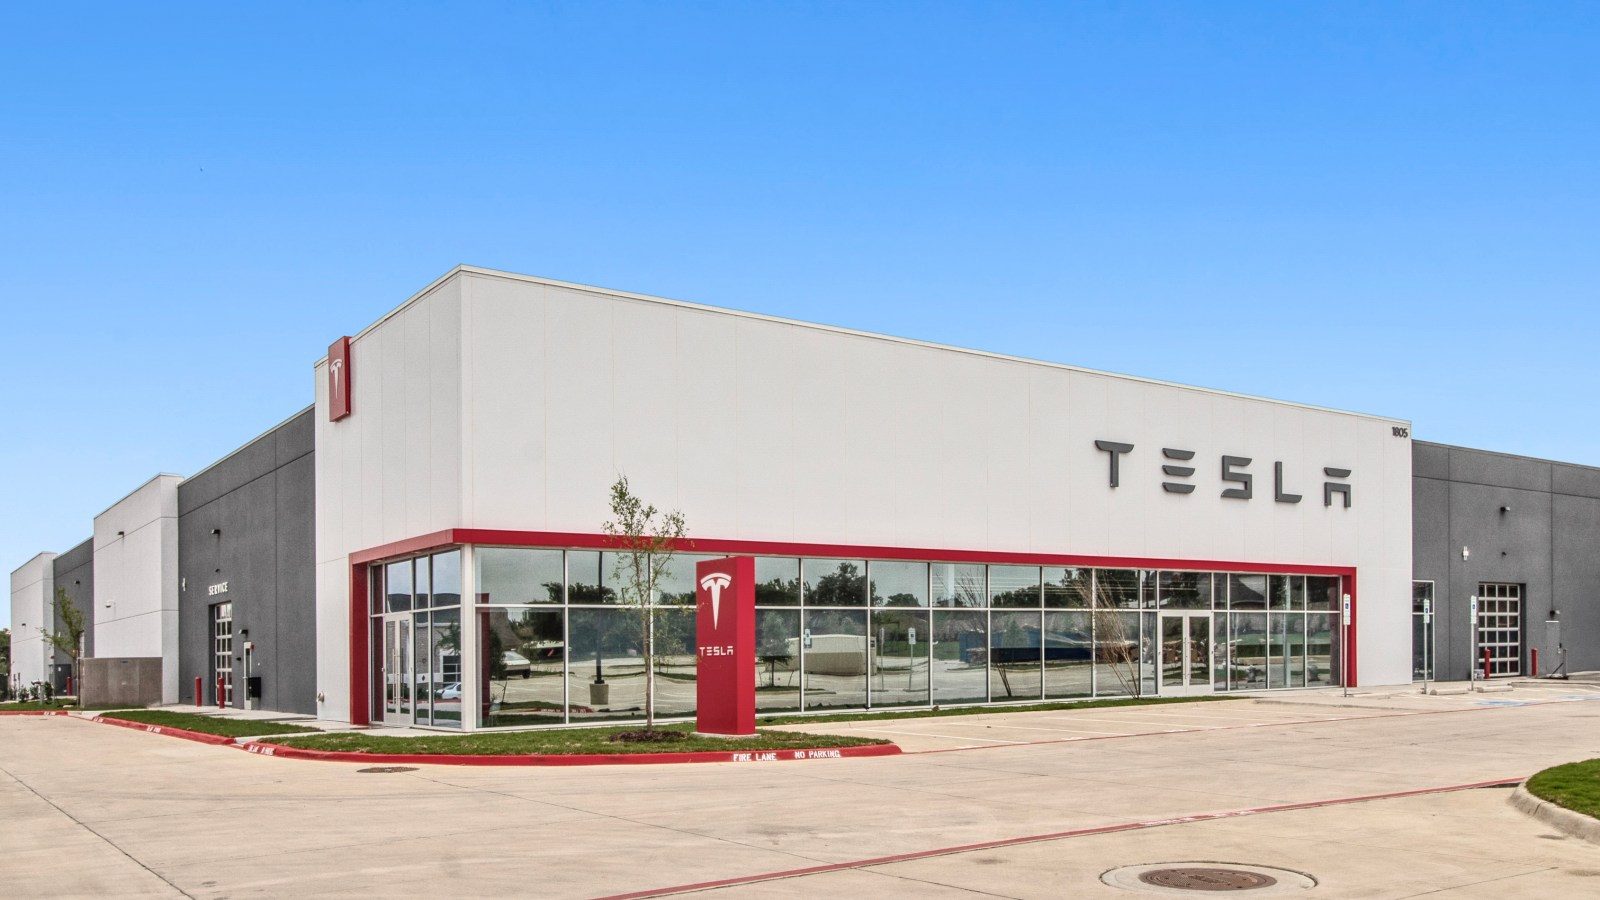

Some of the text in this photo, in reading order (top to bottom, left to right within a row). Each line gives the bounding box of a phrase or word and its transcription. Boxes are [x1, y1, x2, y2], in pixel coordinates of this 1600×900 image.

[1392, 426, 1408, 438] 1805
[1094, 440, 1352, 508] TESLA
[208, 581, 228, 596] SERVICE
[699, 645, 734, 656] TESLA
[733, 749, 841, 762] FIRE LANE NO PARKING
